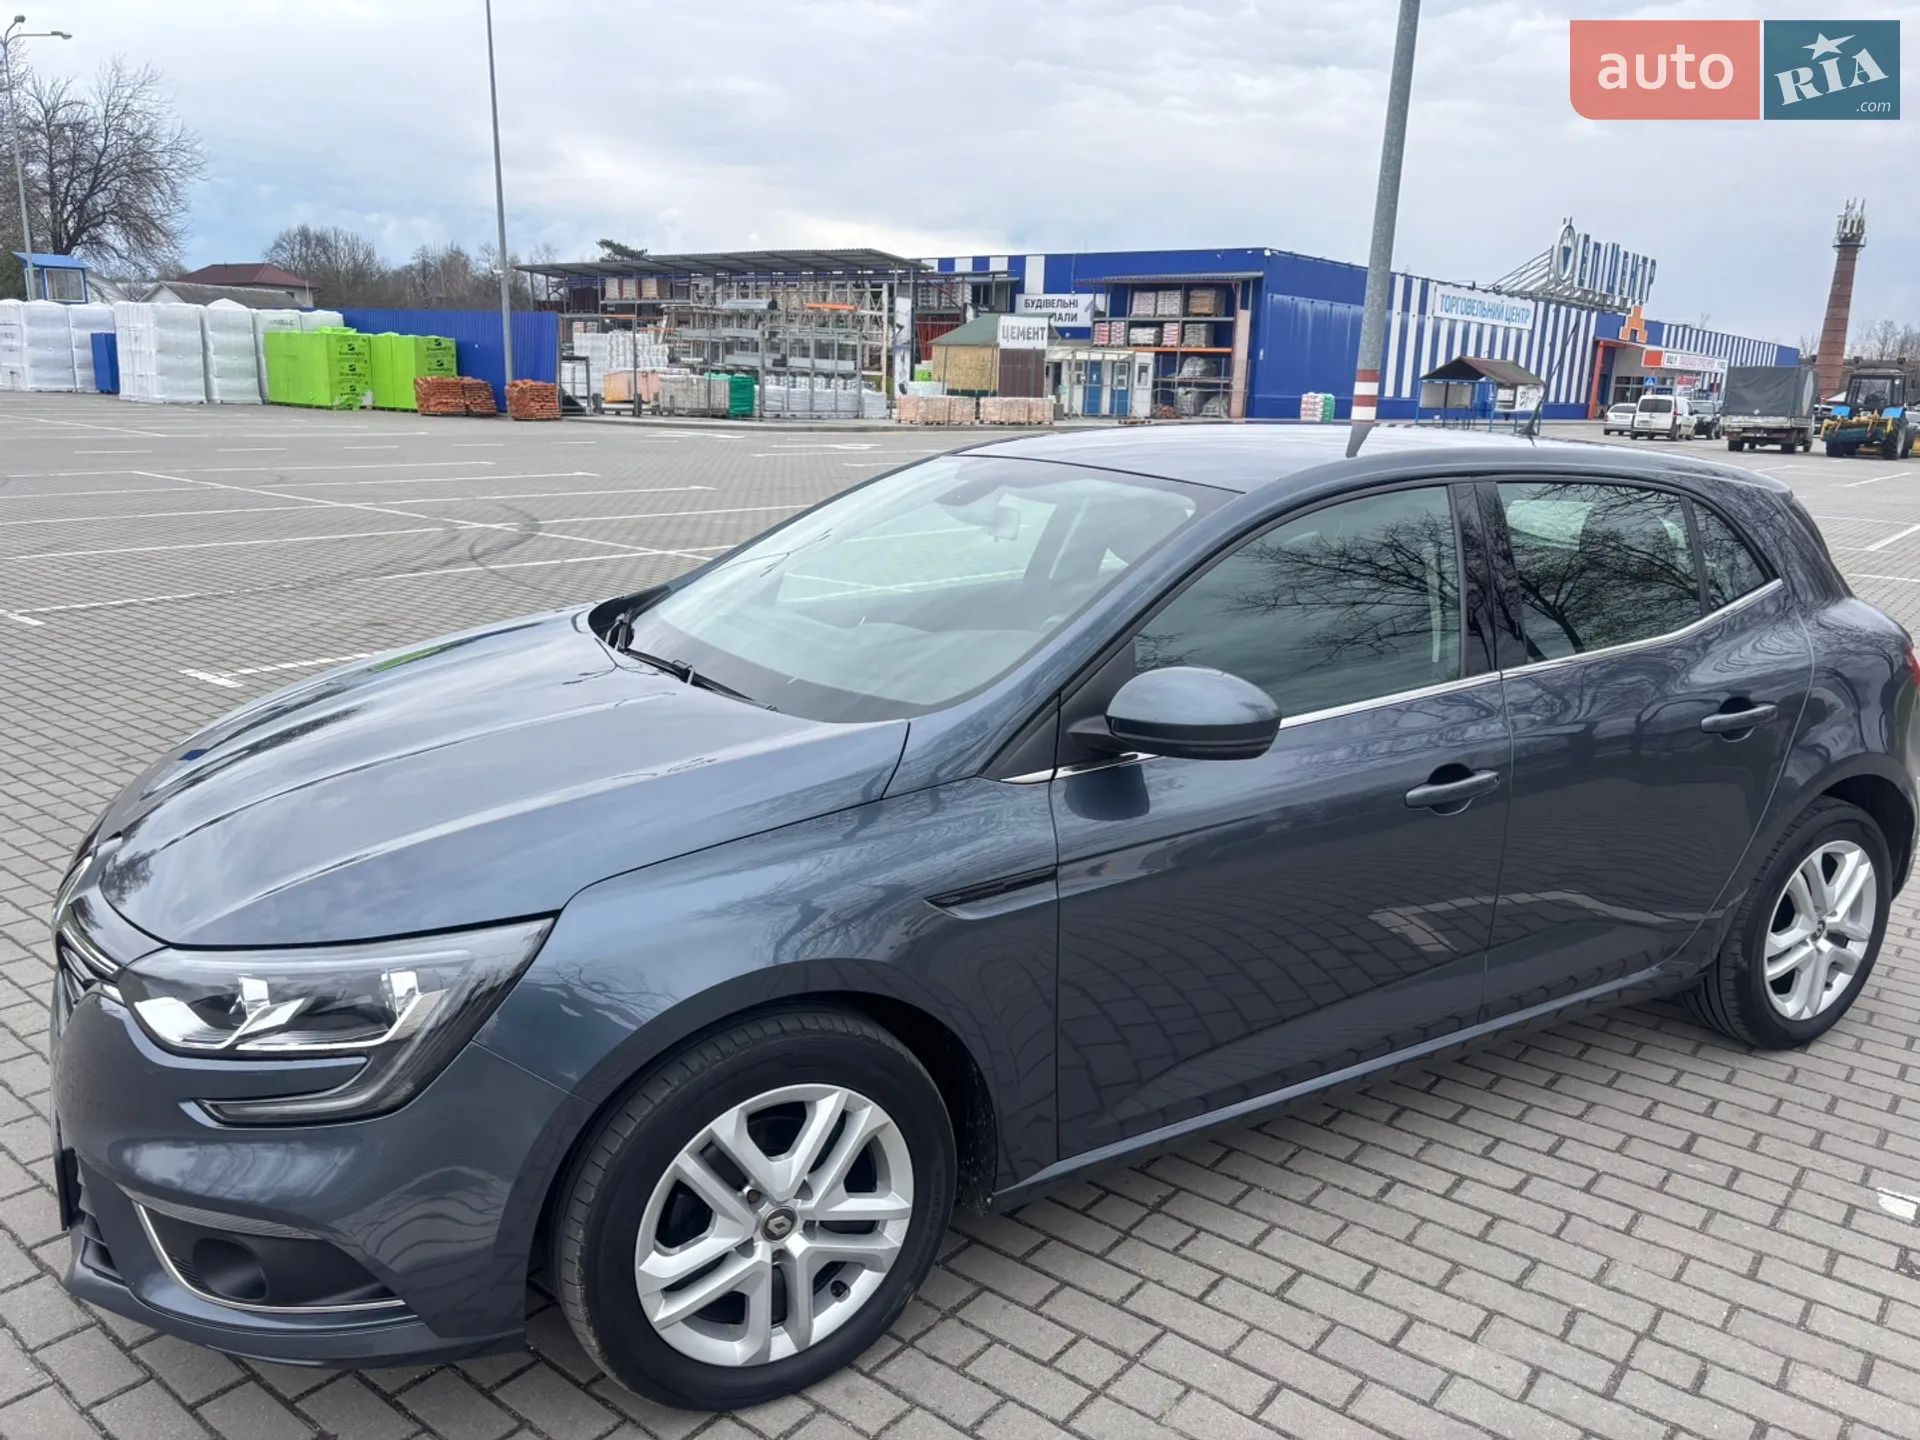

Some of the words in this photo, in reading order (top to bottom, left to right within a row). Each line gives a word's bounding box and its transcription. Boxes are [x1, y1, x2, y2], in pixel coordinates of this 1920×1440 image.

[1024, 298, 1079, 310] БУДІВЕЛЬНІ
[1439, 293, 1505, 321] ТОРГОВЕЛЬНИЙ
[1504, 304, 1531, 325] ЦЕНТР
[1002, 324, 1046, 342] ЦЕМЕНТ
